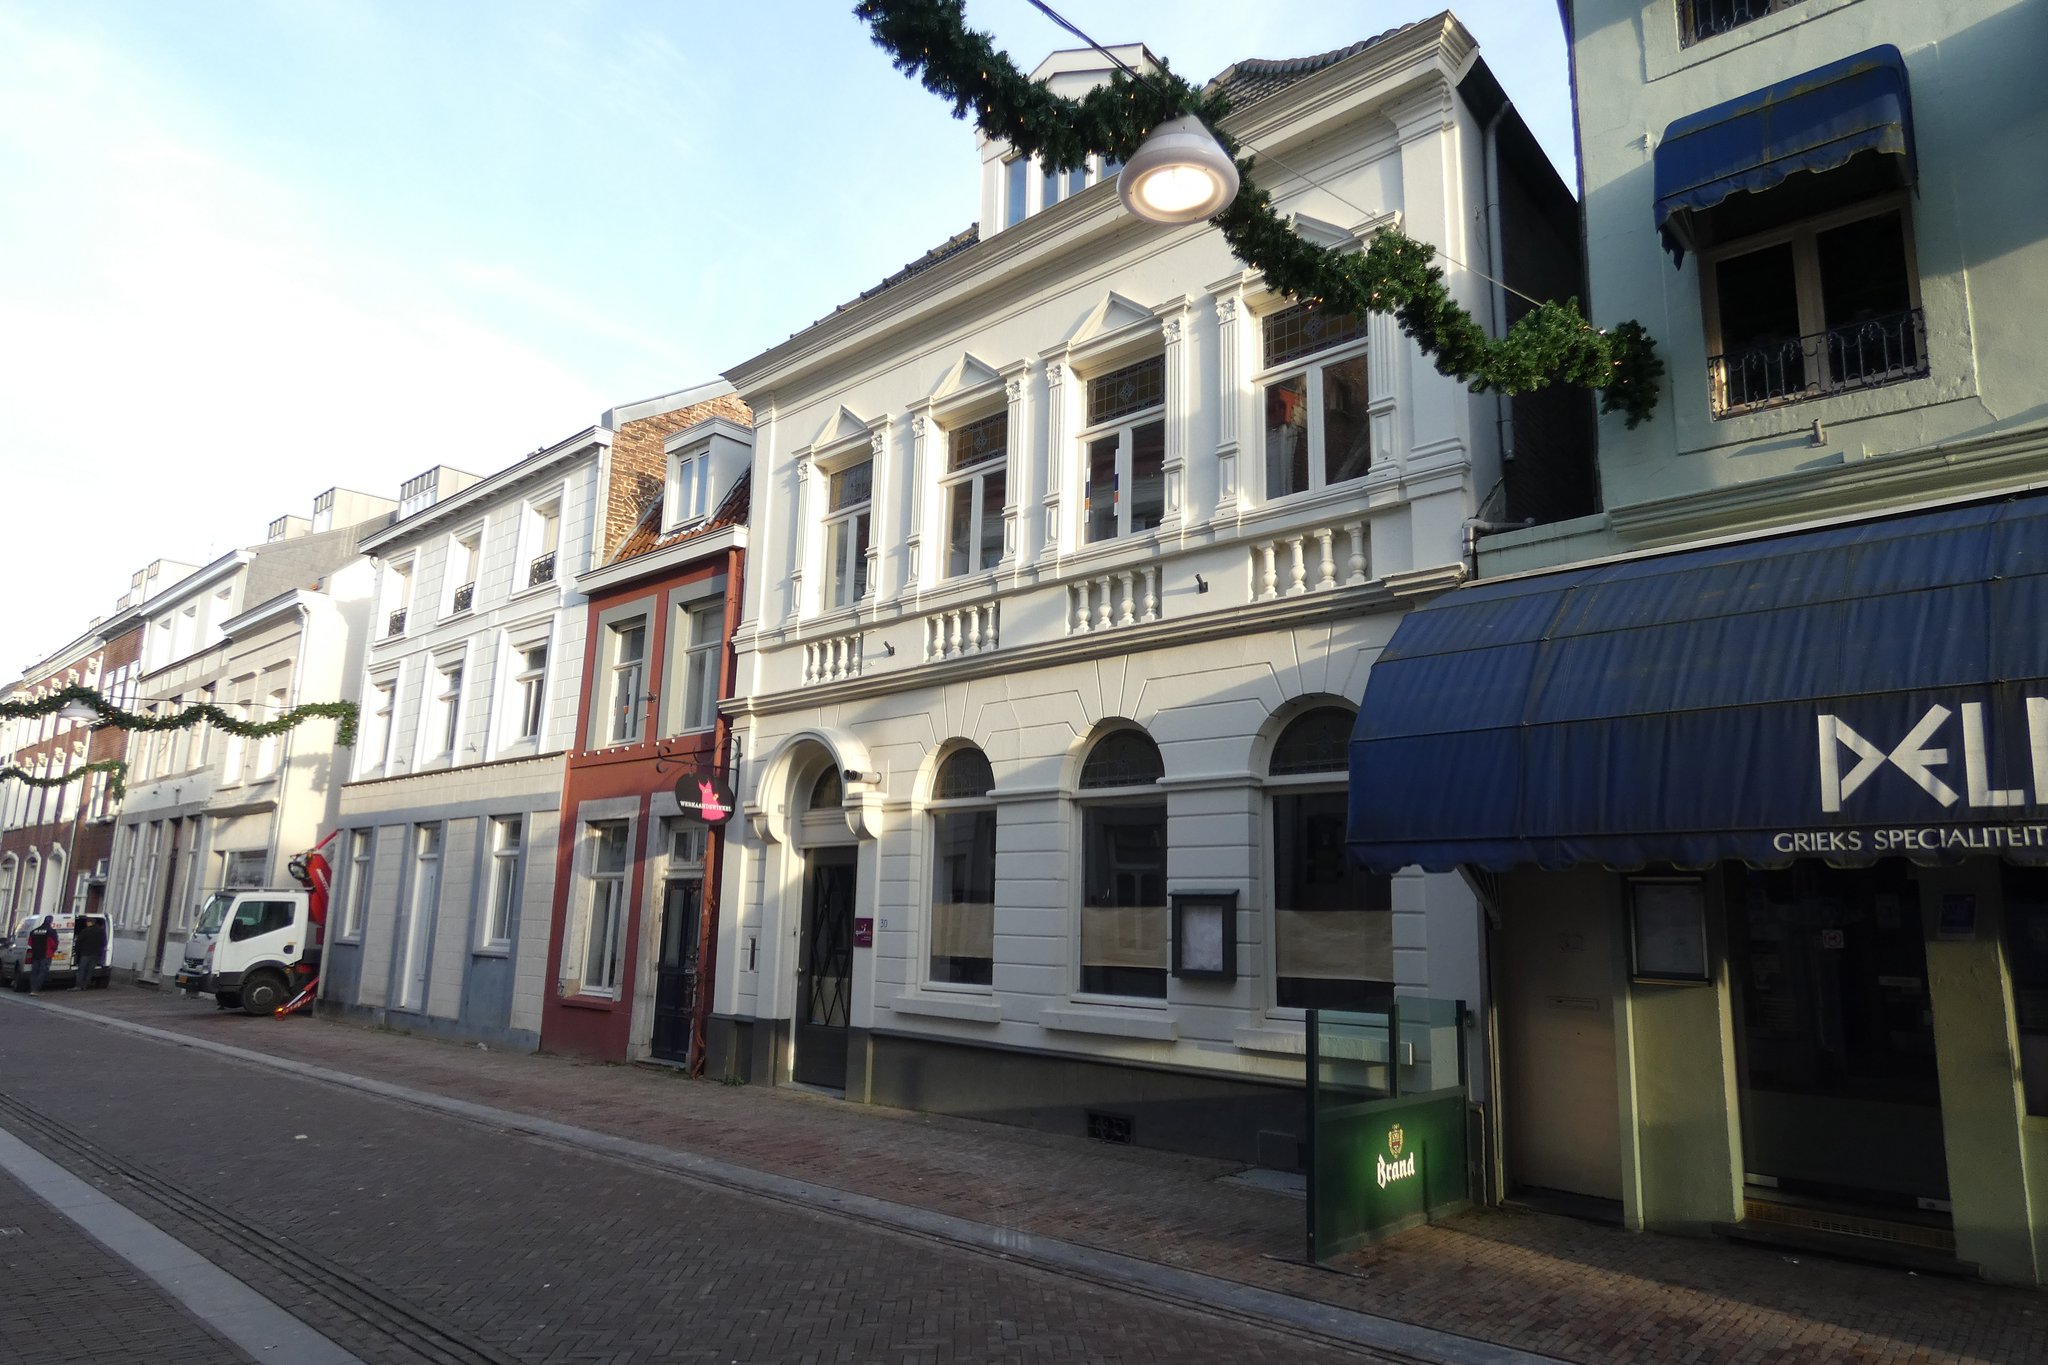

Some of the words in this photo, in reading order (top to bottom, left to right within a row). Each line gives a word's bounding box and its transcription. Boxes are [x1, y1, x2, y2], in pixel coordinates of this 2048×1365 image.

[1773, 831, 1862, 852] GRIEKS
[880, 918, 888, 928] 30
[1377, 1152, 1415, 1189] Brand
